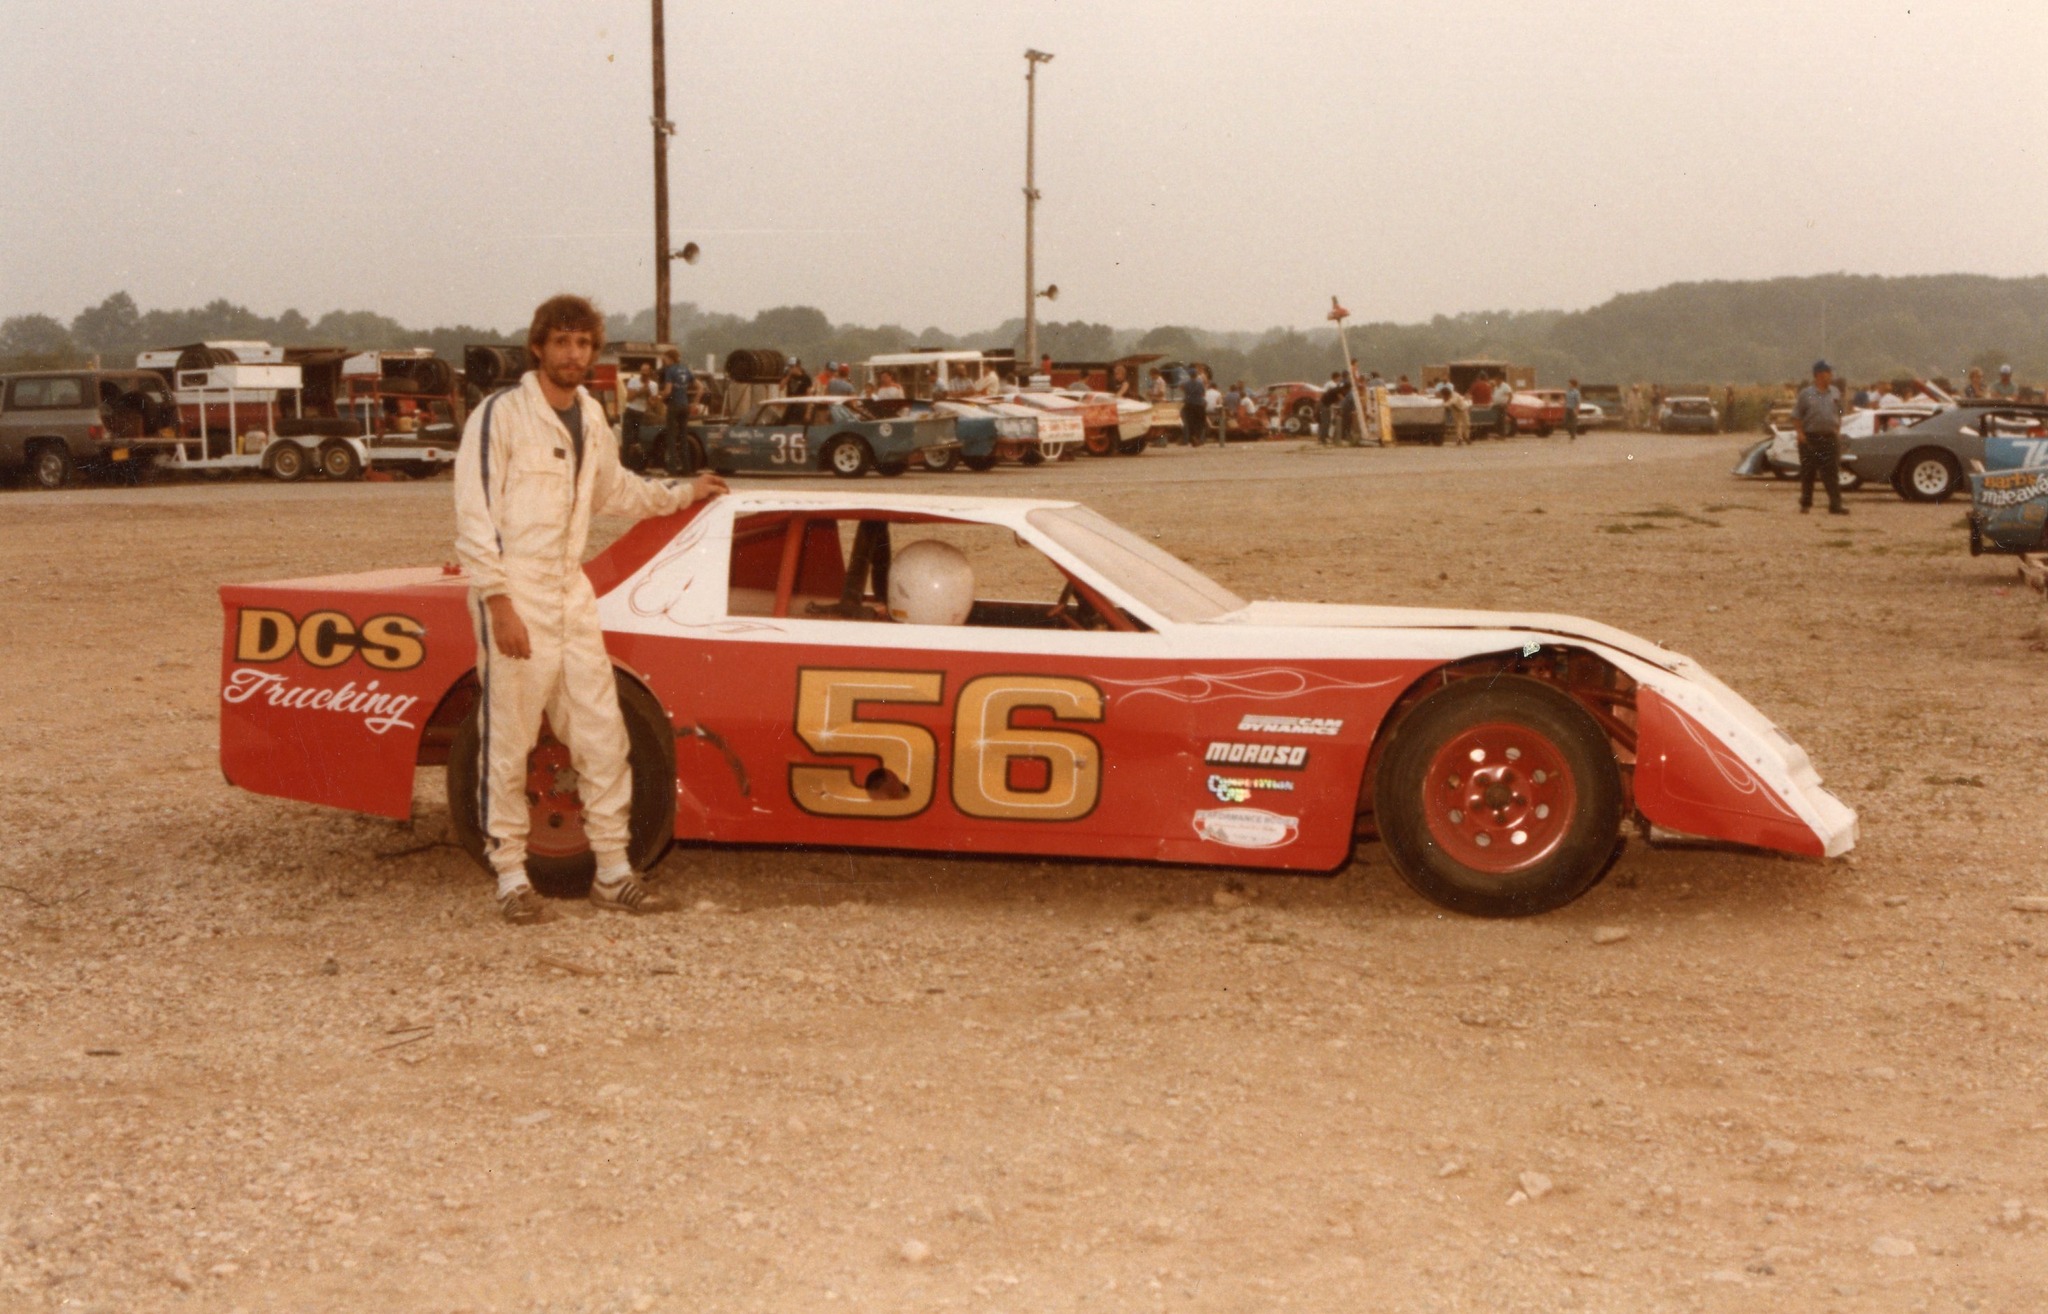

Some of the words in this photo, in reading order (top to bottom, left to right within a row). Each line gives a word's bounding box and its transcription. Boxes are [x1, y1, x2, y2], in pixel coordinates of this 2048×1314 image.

[771, 433, 807, 464] 36
[234, 607, 427, 671] DCS
[223, 668, 418, 734] Trucking
[788, 666, 1105, 823] 56
[1205, 742, 1308, 768] MOROSO
